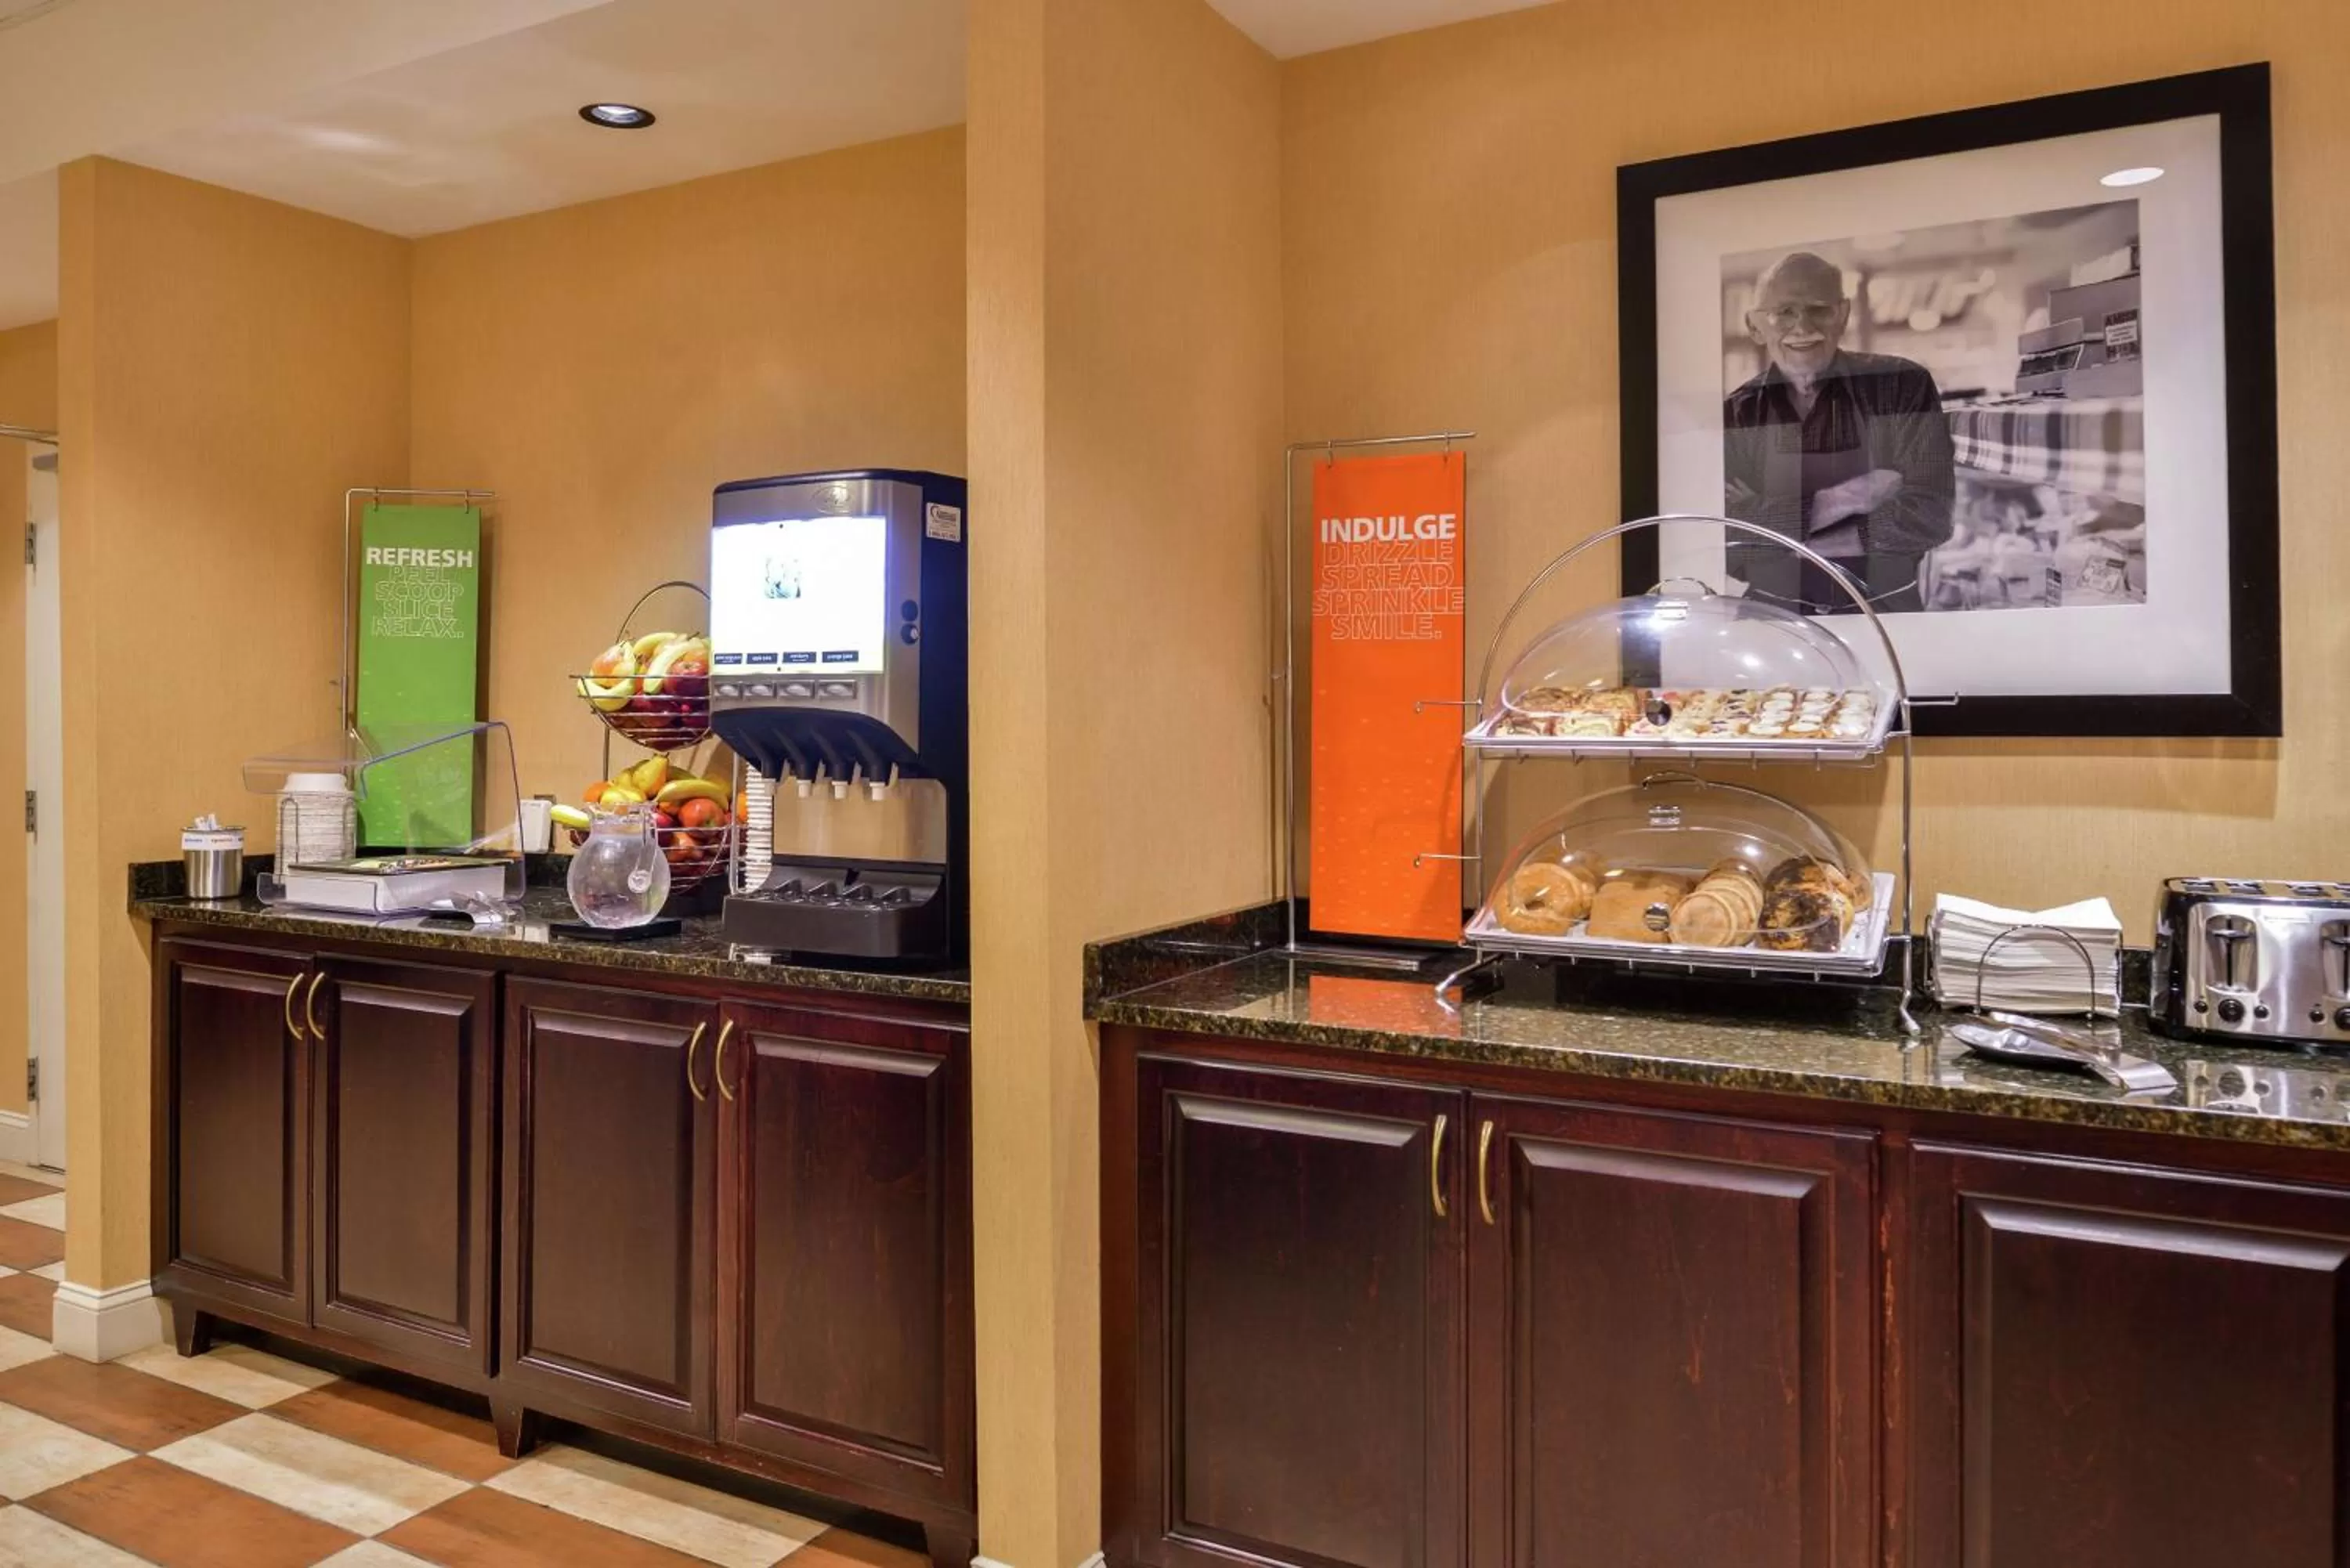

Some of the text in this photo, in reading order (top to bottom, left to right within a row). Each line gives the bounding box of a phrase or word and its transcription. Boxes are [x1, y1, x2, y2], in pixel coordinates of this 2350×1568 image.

[1321, 514, 1457, 543] INDULGE
[366, 547, 473, 568] REFRESH
[1324, 538, 1455, 565] DRIZZLE
[1321, 562, 1455, 592] SPREAD
[375, 580, 465, 602] SCOOP
[1313, 587, 1464, 616] SPRINKLE
[382, 600, 455, 621] SLICE
[371, 615, 465, 639] RELAX.
[1331, 612, 1442, 640] SMILE.
